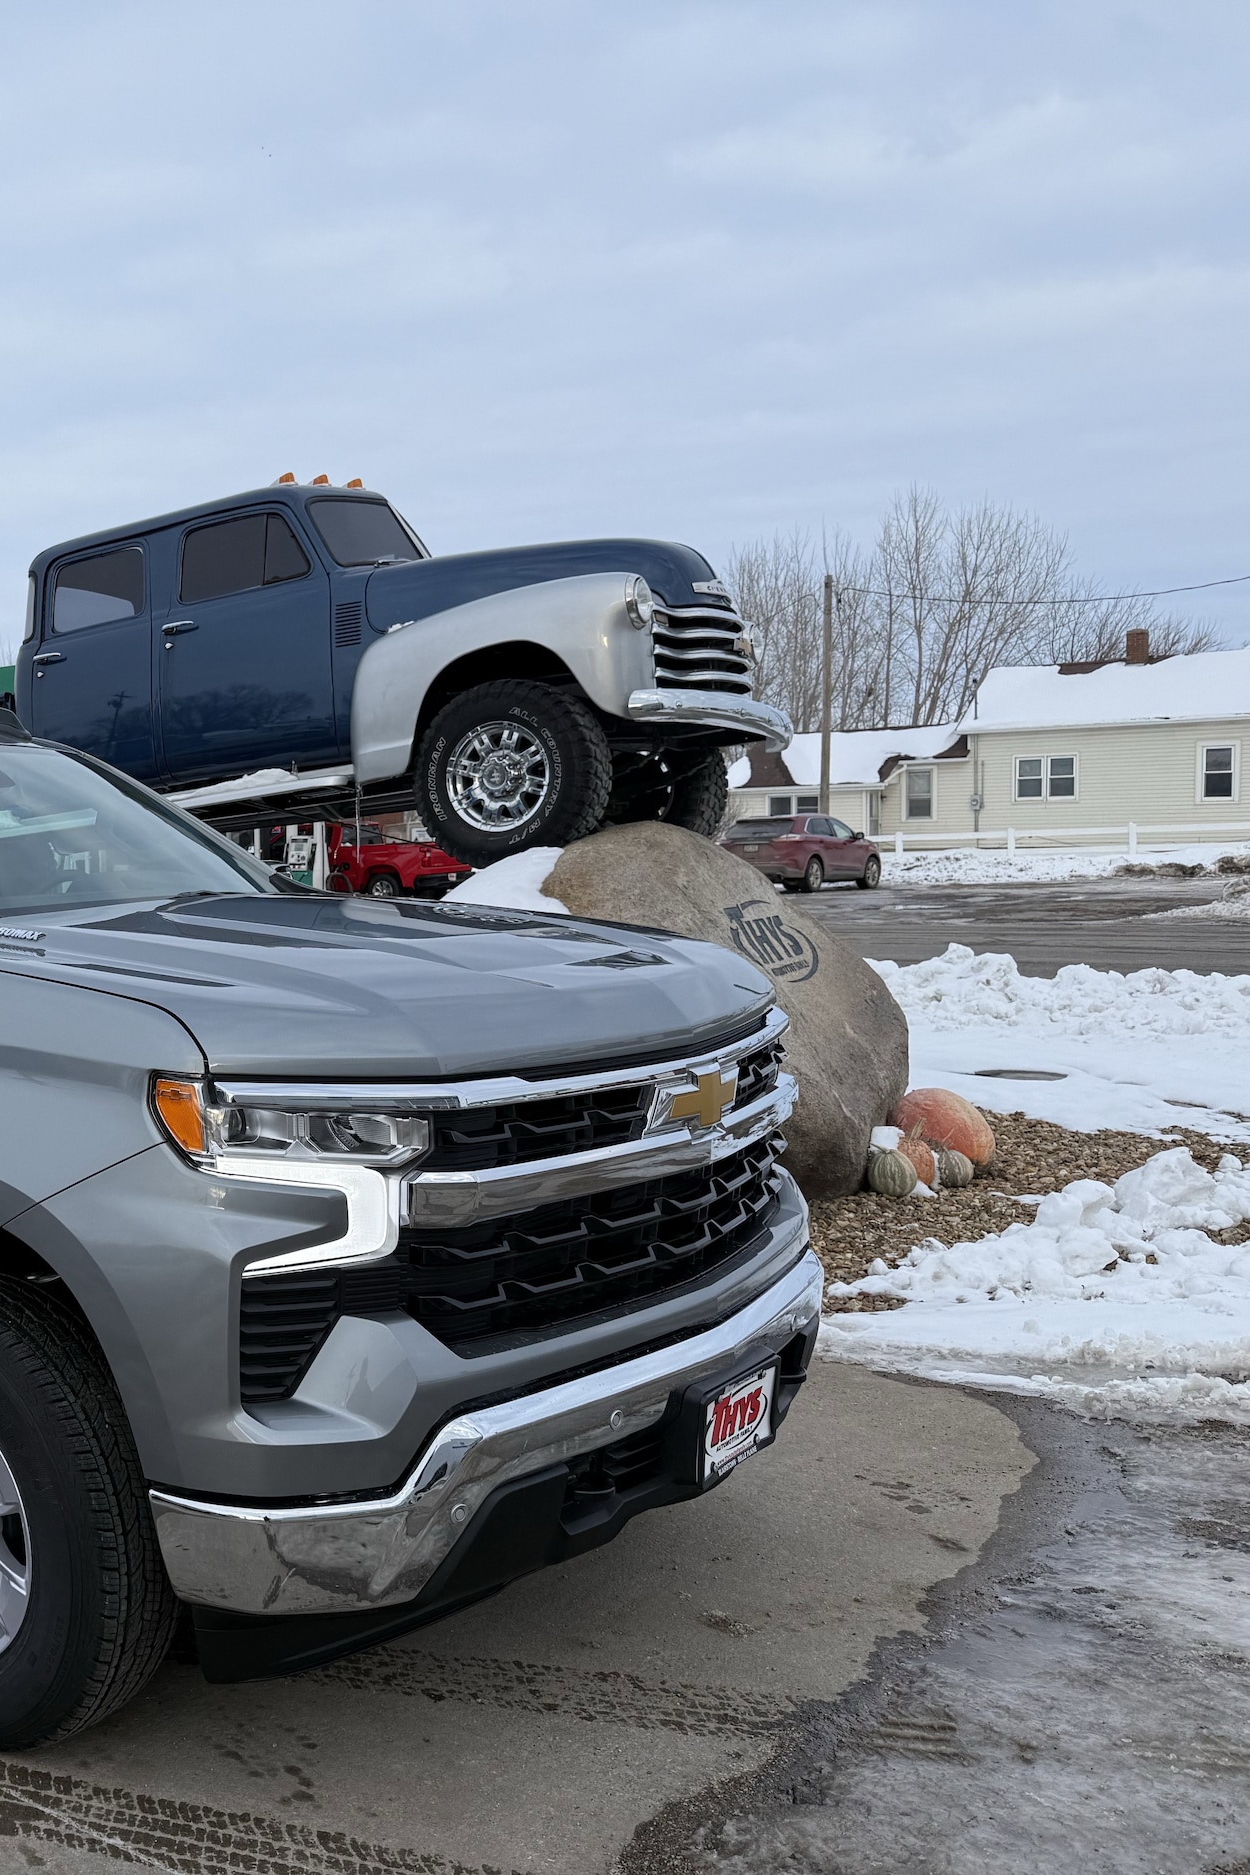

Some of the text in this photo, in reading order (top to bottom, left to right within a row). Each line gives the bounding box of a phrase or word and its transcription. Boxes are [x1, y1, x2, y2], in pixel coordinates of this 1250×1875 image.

[508, 706, 539, 727] ALL
[427, 736, 448, 822] IRONMAN
[540, 727, 562, 818] COUNTRY
[723, 904, 804, 964] THYS
[711, 1385, 763, 1449] THYS
[716, 1425, 753, 1453] AUTOMOTIVE FAMILY
